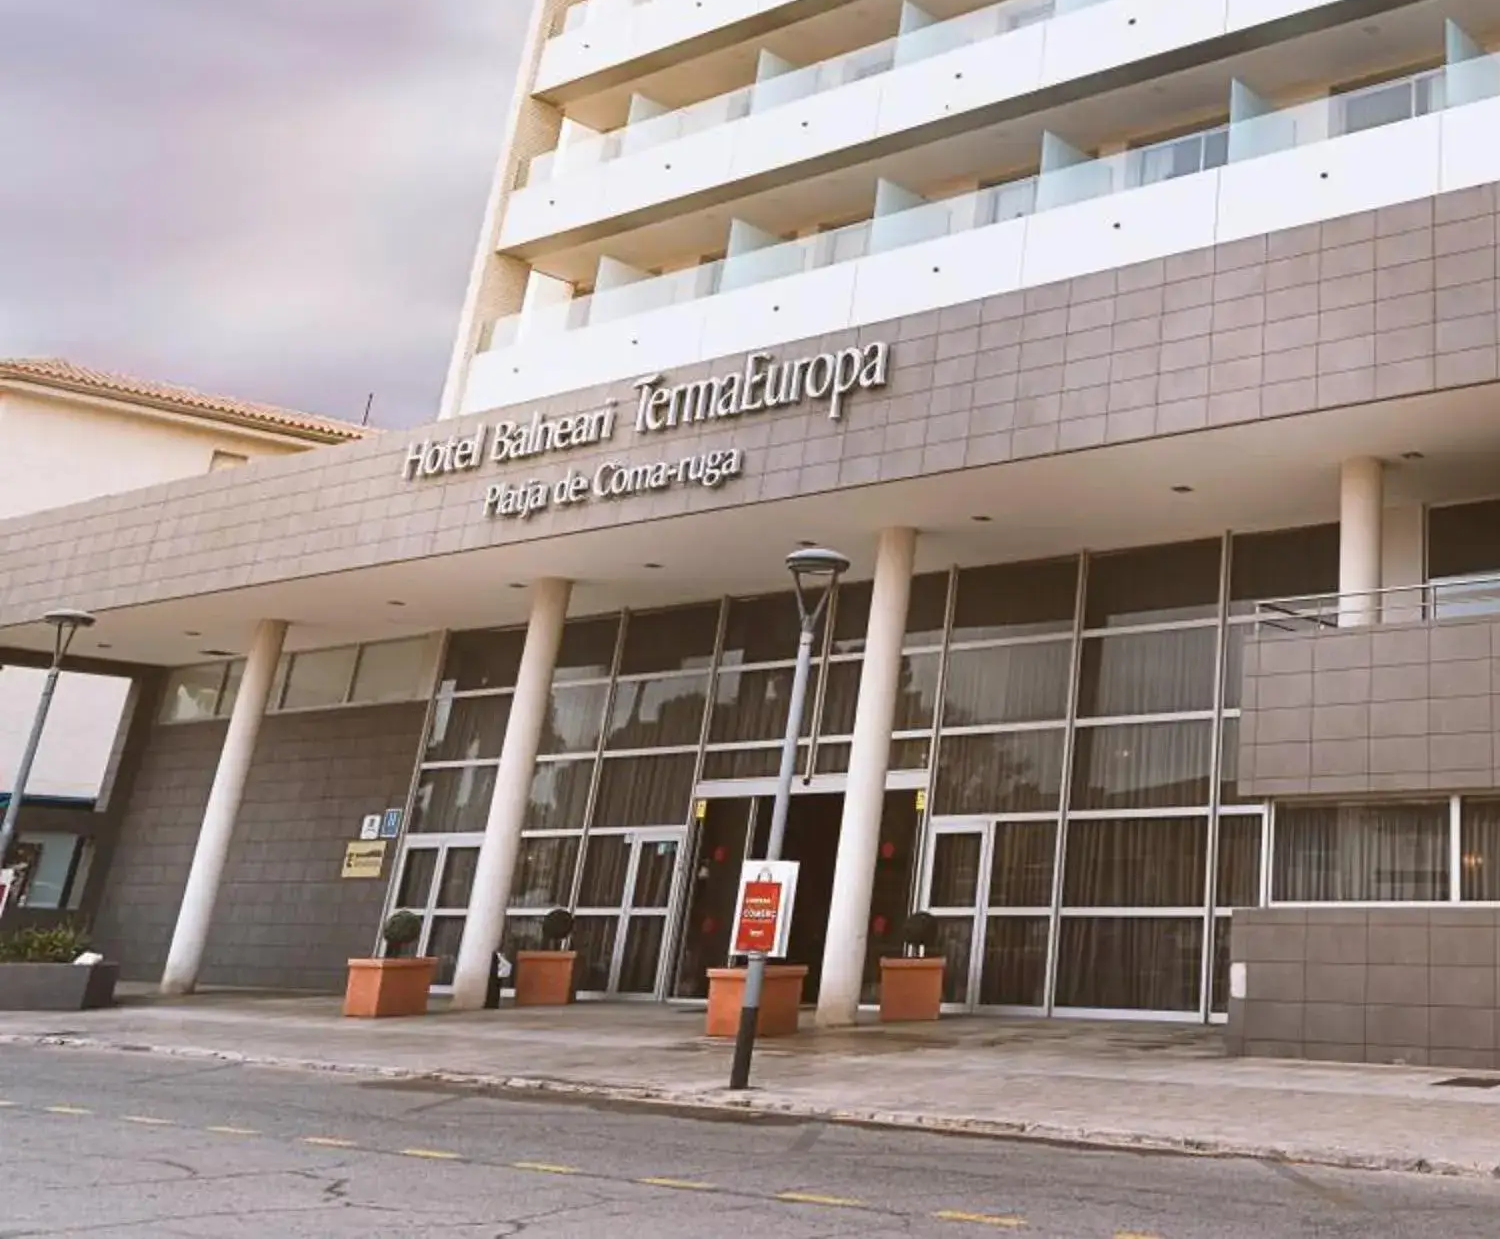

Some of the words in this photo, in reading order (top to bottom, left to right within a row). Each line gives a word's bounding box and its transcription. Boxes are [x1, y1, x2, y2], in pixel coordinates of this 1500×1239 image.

[402, 422, 484, 479] Hotel
[490, 401, 615, 462] Balneari
[634, 341, 888, 433] TermaEuropa
[482, 479, 549, 519] Platja
[553, 468, 588, 505] de
[593, 448, 743, 498] Coma-ruga
